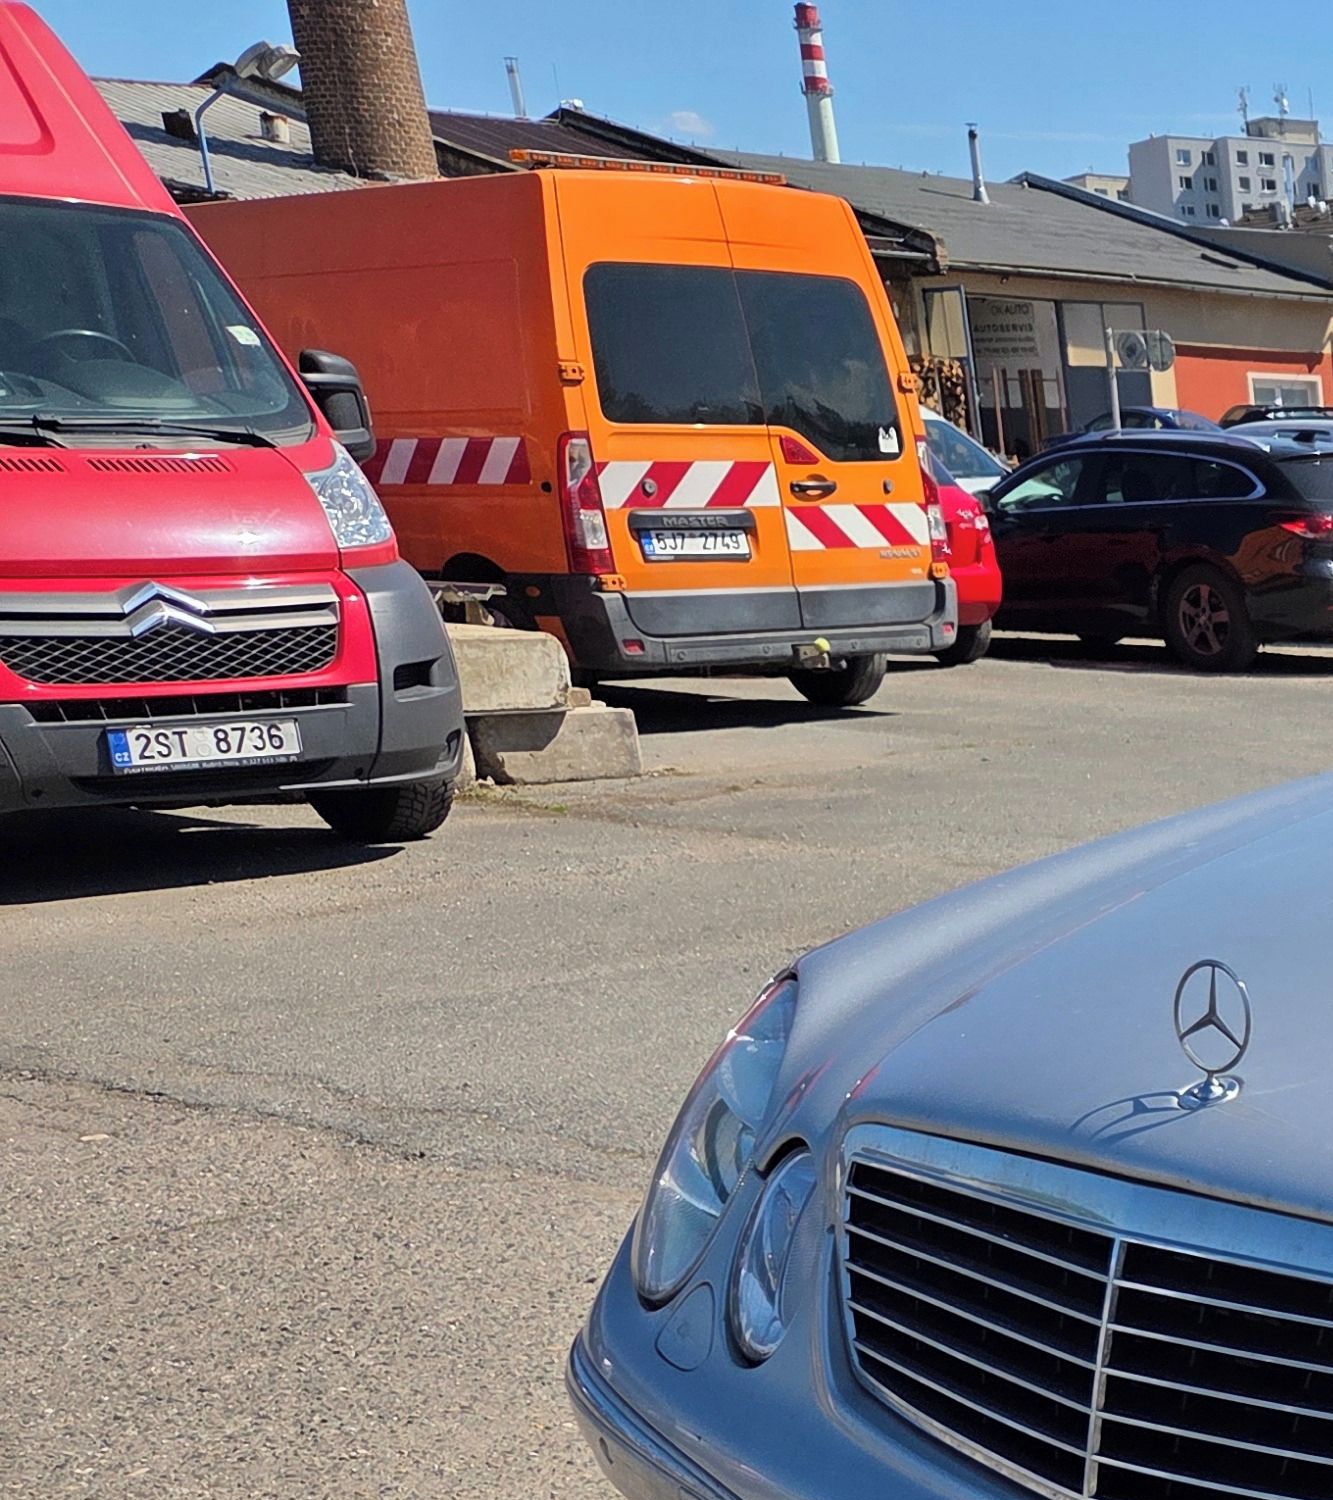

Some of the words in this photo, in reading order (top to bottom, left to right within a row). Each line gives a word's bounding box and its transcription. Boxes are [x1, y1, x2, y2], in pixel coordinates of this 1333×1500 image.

[662, 515, 728, 527] MASTER
[655, 532, 685, 550] 5J7
[699, 532, 741, 550] 2749
[134, 730, 188, 760] 2ST
[213, 723, 284, 755] 8736
[114, 751, 130, 762] CZ
